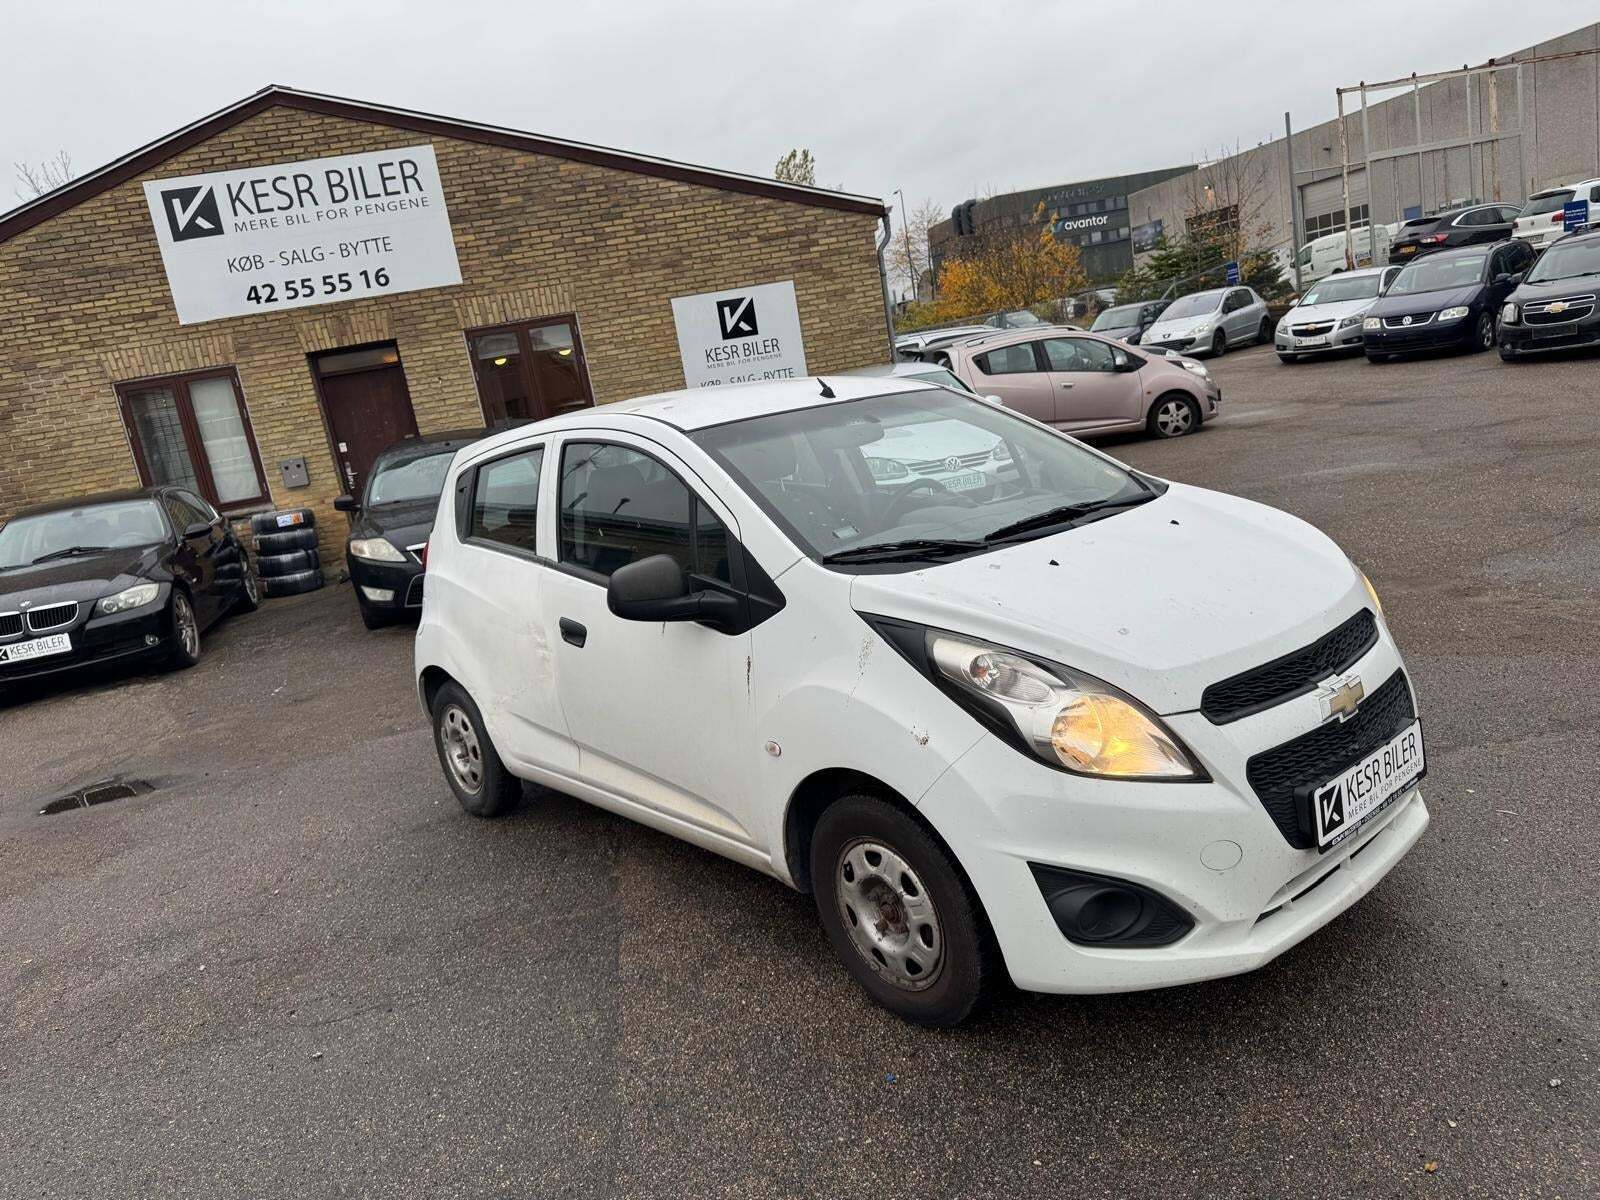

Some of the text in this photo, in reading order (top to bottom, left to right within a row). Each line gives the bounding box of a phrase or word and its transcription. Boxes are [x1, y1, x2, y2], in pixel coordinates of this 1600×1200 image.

[226, 159, 424, 217] KESR BILER
[233, 196, 431, 233] MERE BIL FOR PENGENE
[1065, 216, 1108, 230] avantor
[227, 255, 265, 273] KØB
[279, 246, 325, 267] SALG
[339, 236, 394, 259] BYTTE
[246, 266, 390, 305] 42 55 55 16
[705, 338, 780, 363] KESR BILER
[10, 643, 35, 656] KESR
[37, 636, 64, 650] BILER
[1345, 732, 1417, 806] KESR BILER
[1348, 799, 1368, 819] MERE
[1369, 792, 1379, 806] BIL
[1394, 757, 1422, 785] PENGENE
